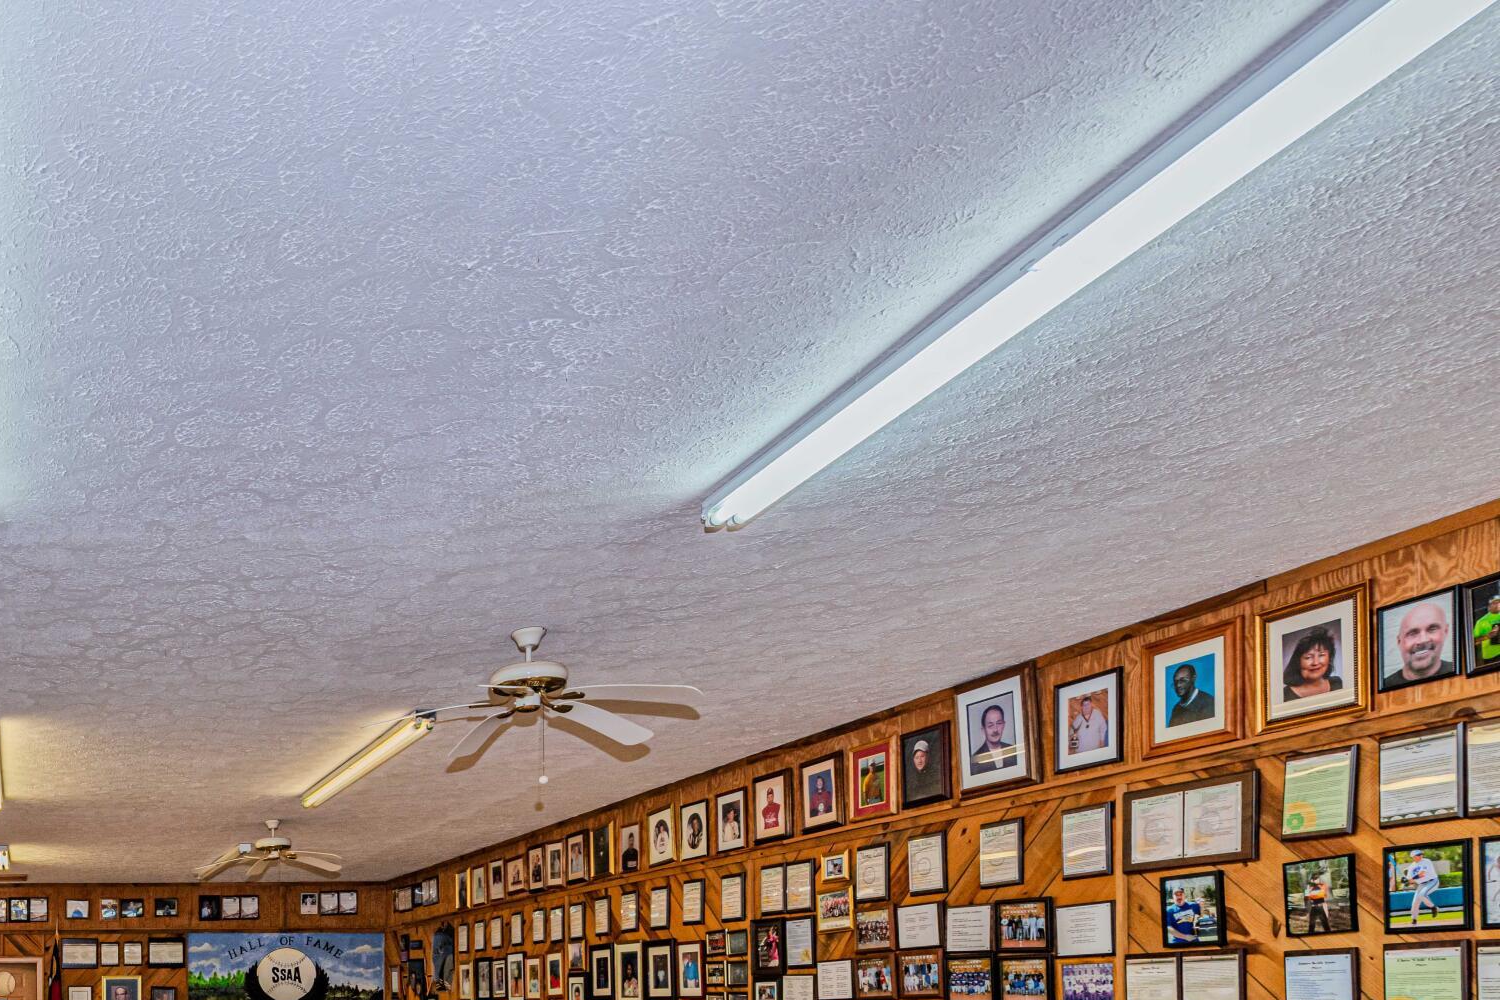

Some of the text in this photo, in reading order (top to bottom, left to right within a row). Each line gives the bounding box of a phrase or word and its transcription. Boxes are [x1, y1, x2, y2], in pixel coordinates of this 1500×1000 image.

[227, 936, 345, 960] HALL OF FAME
[271, 966, 303, 984] SSAA
